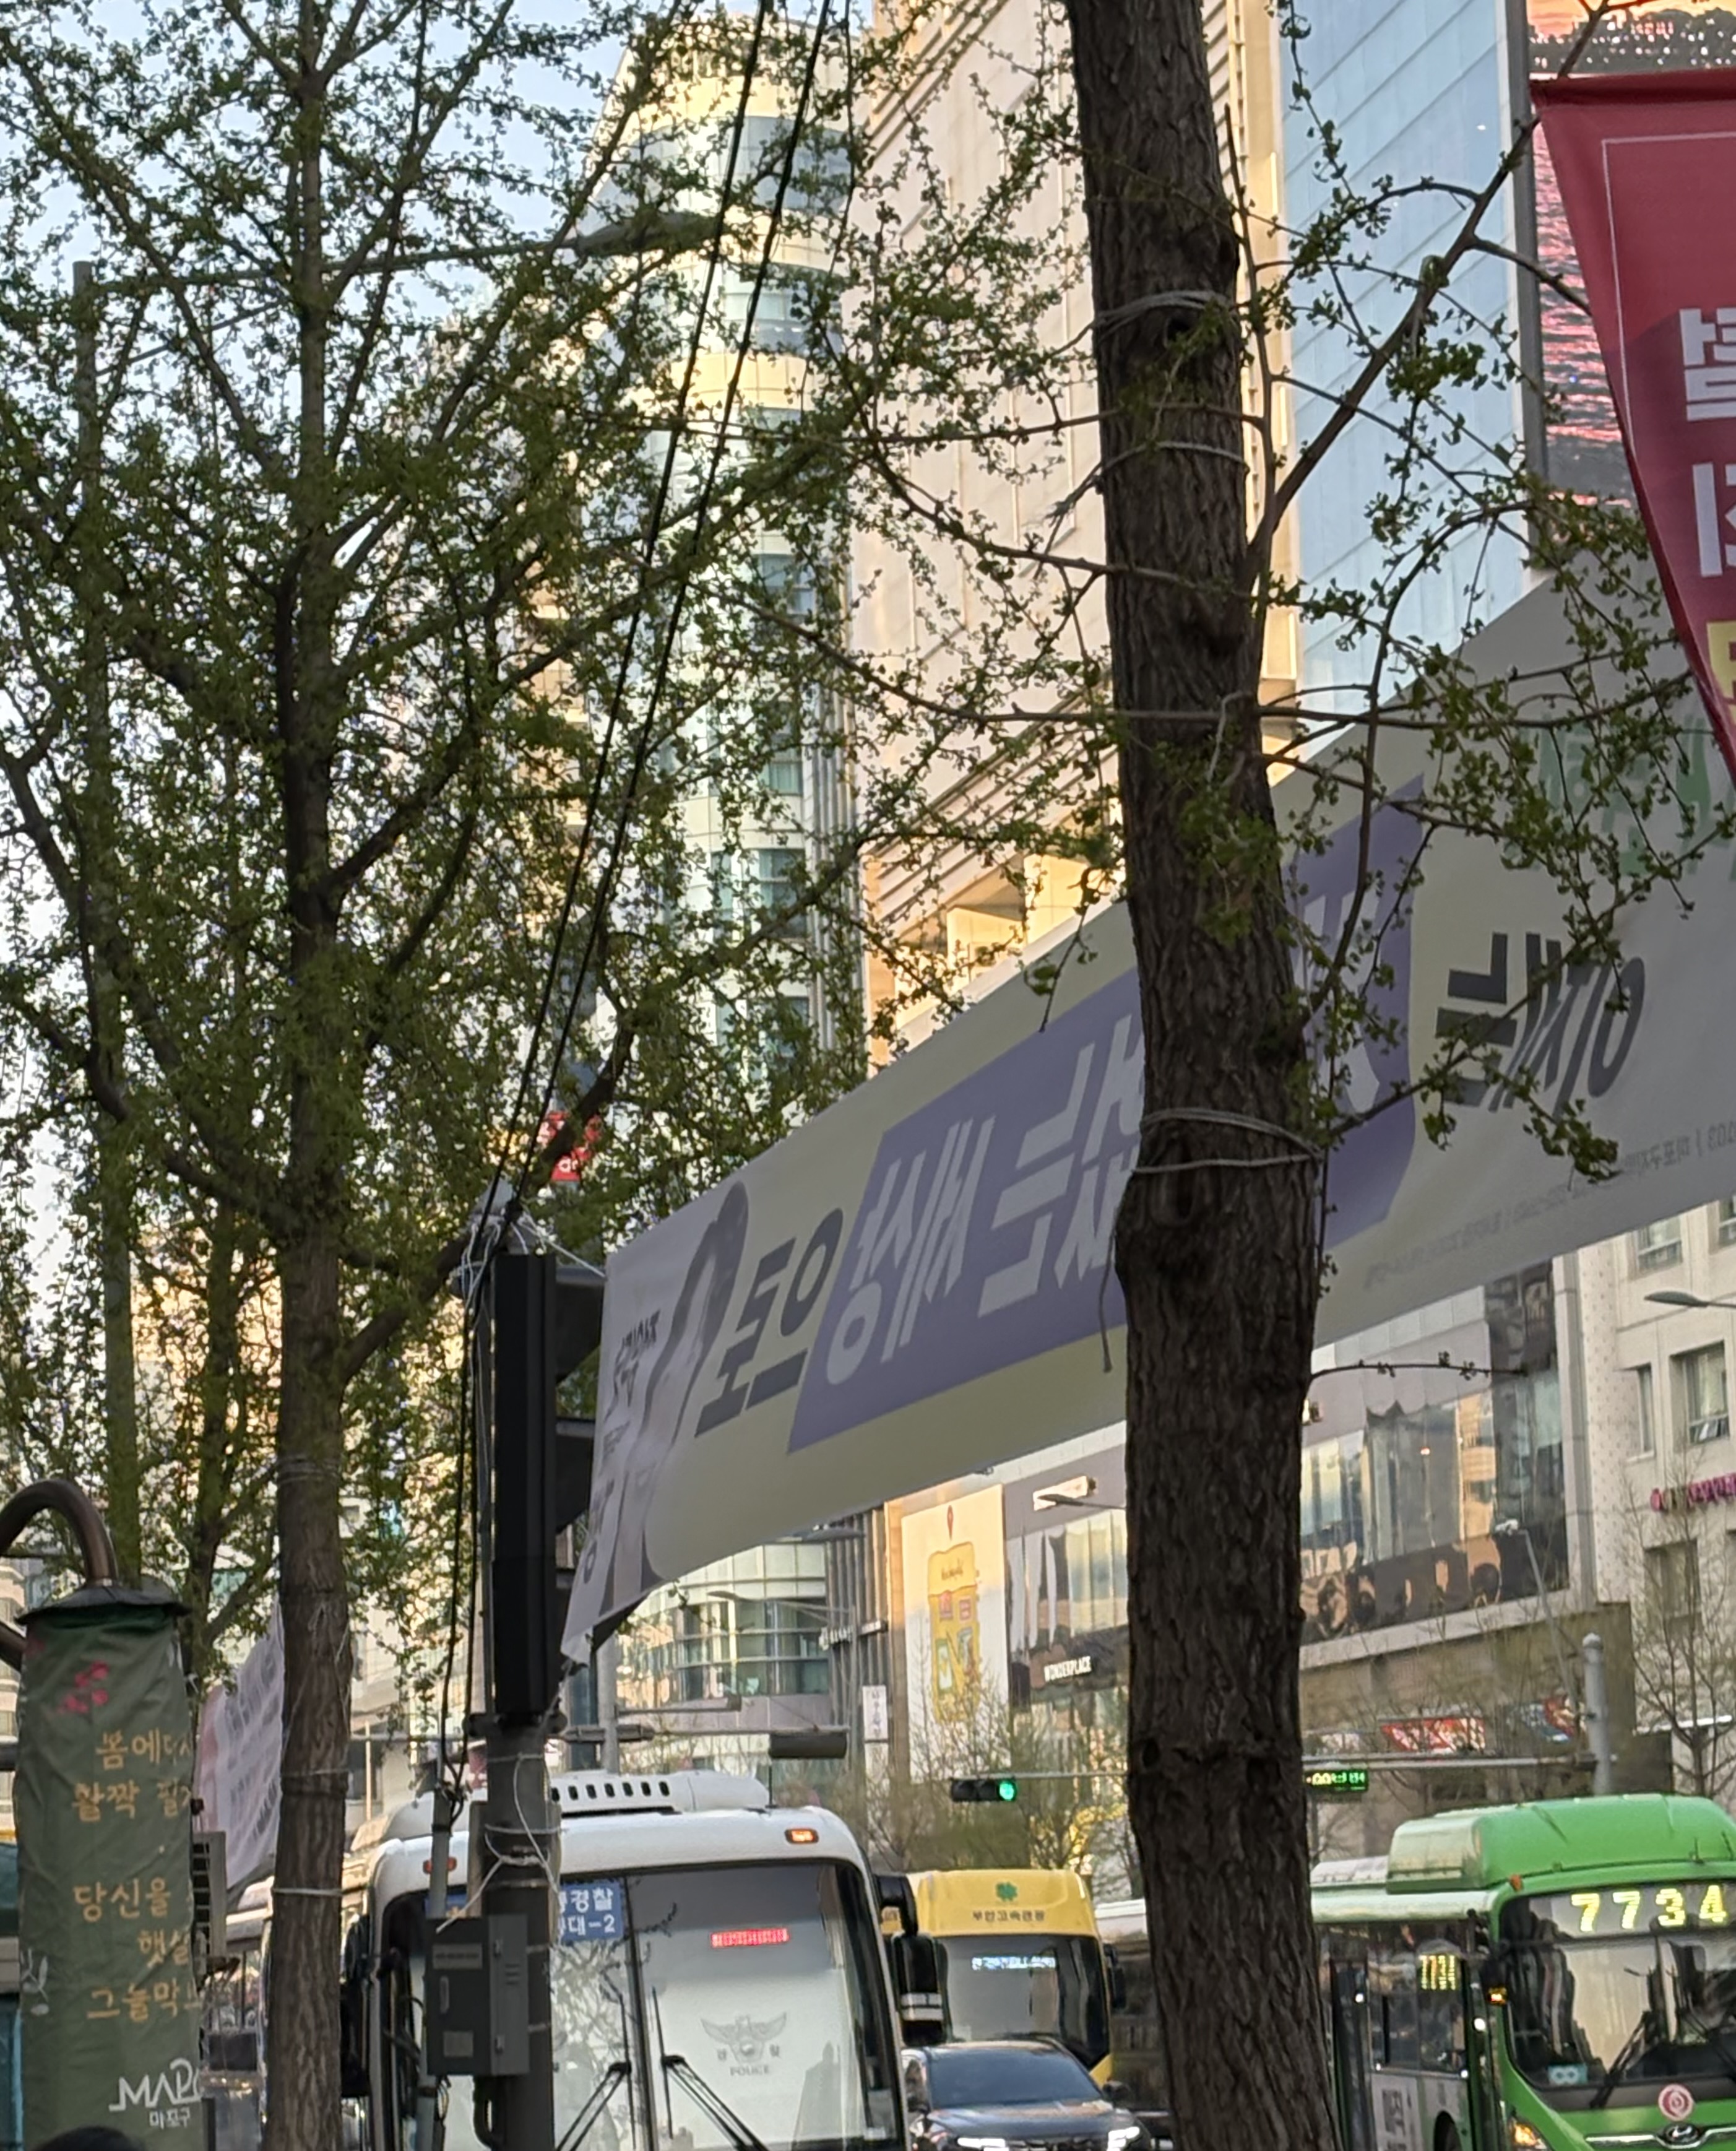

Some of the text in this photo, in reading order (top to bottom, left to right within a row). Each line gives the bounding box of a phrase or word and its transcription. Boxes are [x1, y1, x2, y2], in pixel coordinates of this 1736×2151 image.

[74, 1877, 171, 1922] 당신을
[1570, 1884, 1728, 1932] 7734
[149, 2106, 190, 2129] 마포구
